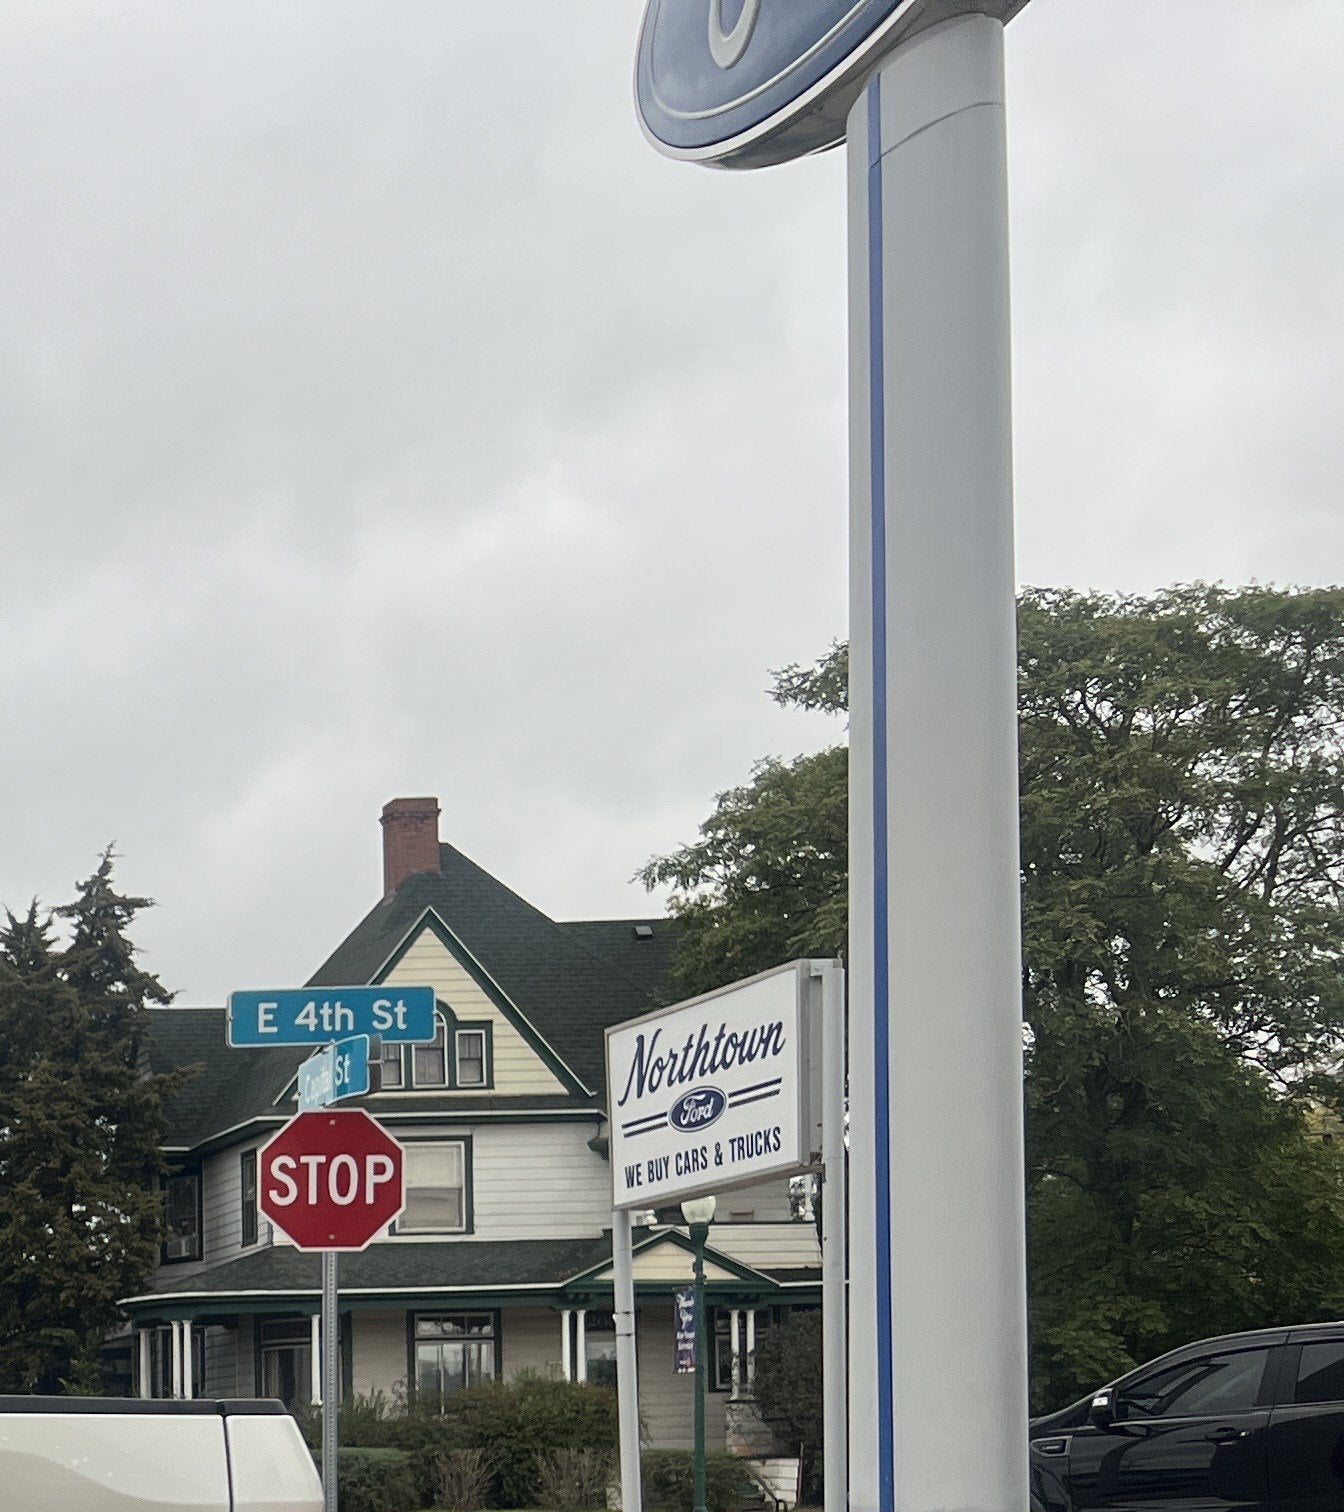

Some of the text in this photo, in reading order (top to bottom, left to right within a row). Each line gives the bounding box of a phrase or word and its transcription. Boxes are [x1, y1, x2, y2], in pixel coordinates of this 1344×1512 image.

[257, 999, 407, 1033] E 4th St
[334, 1053, 351, 1086] St
[618, 1021, 786, 1106] Northtown
[680, 1094, 715, 1126] Ford
[625, 1126, 781, 1188] WE BUY CARS & TRUCKS
[268, 1153, 395, 1206] STOP
